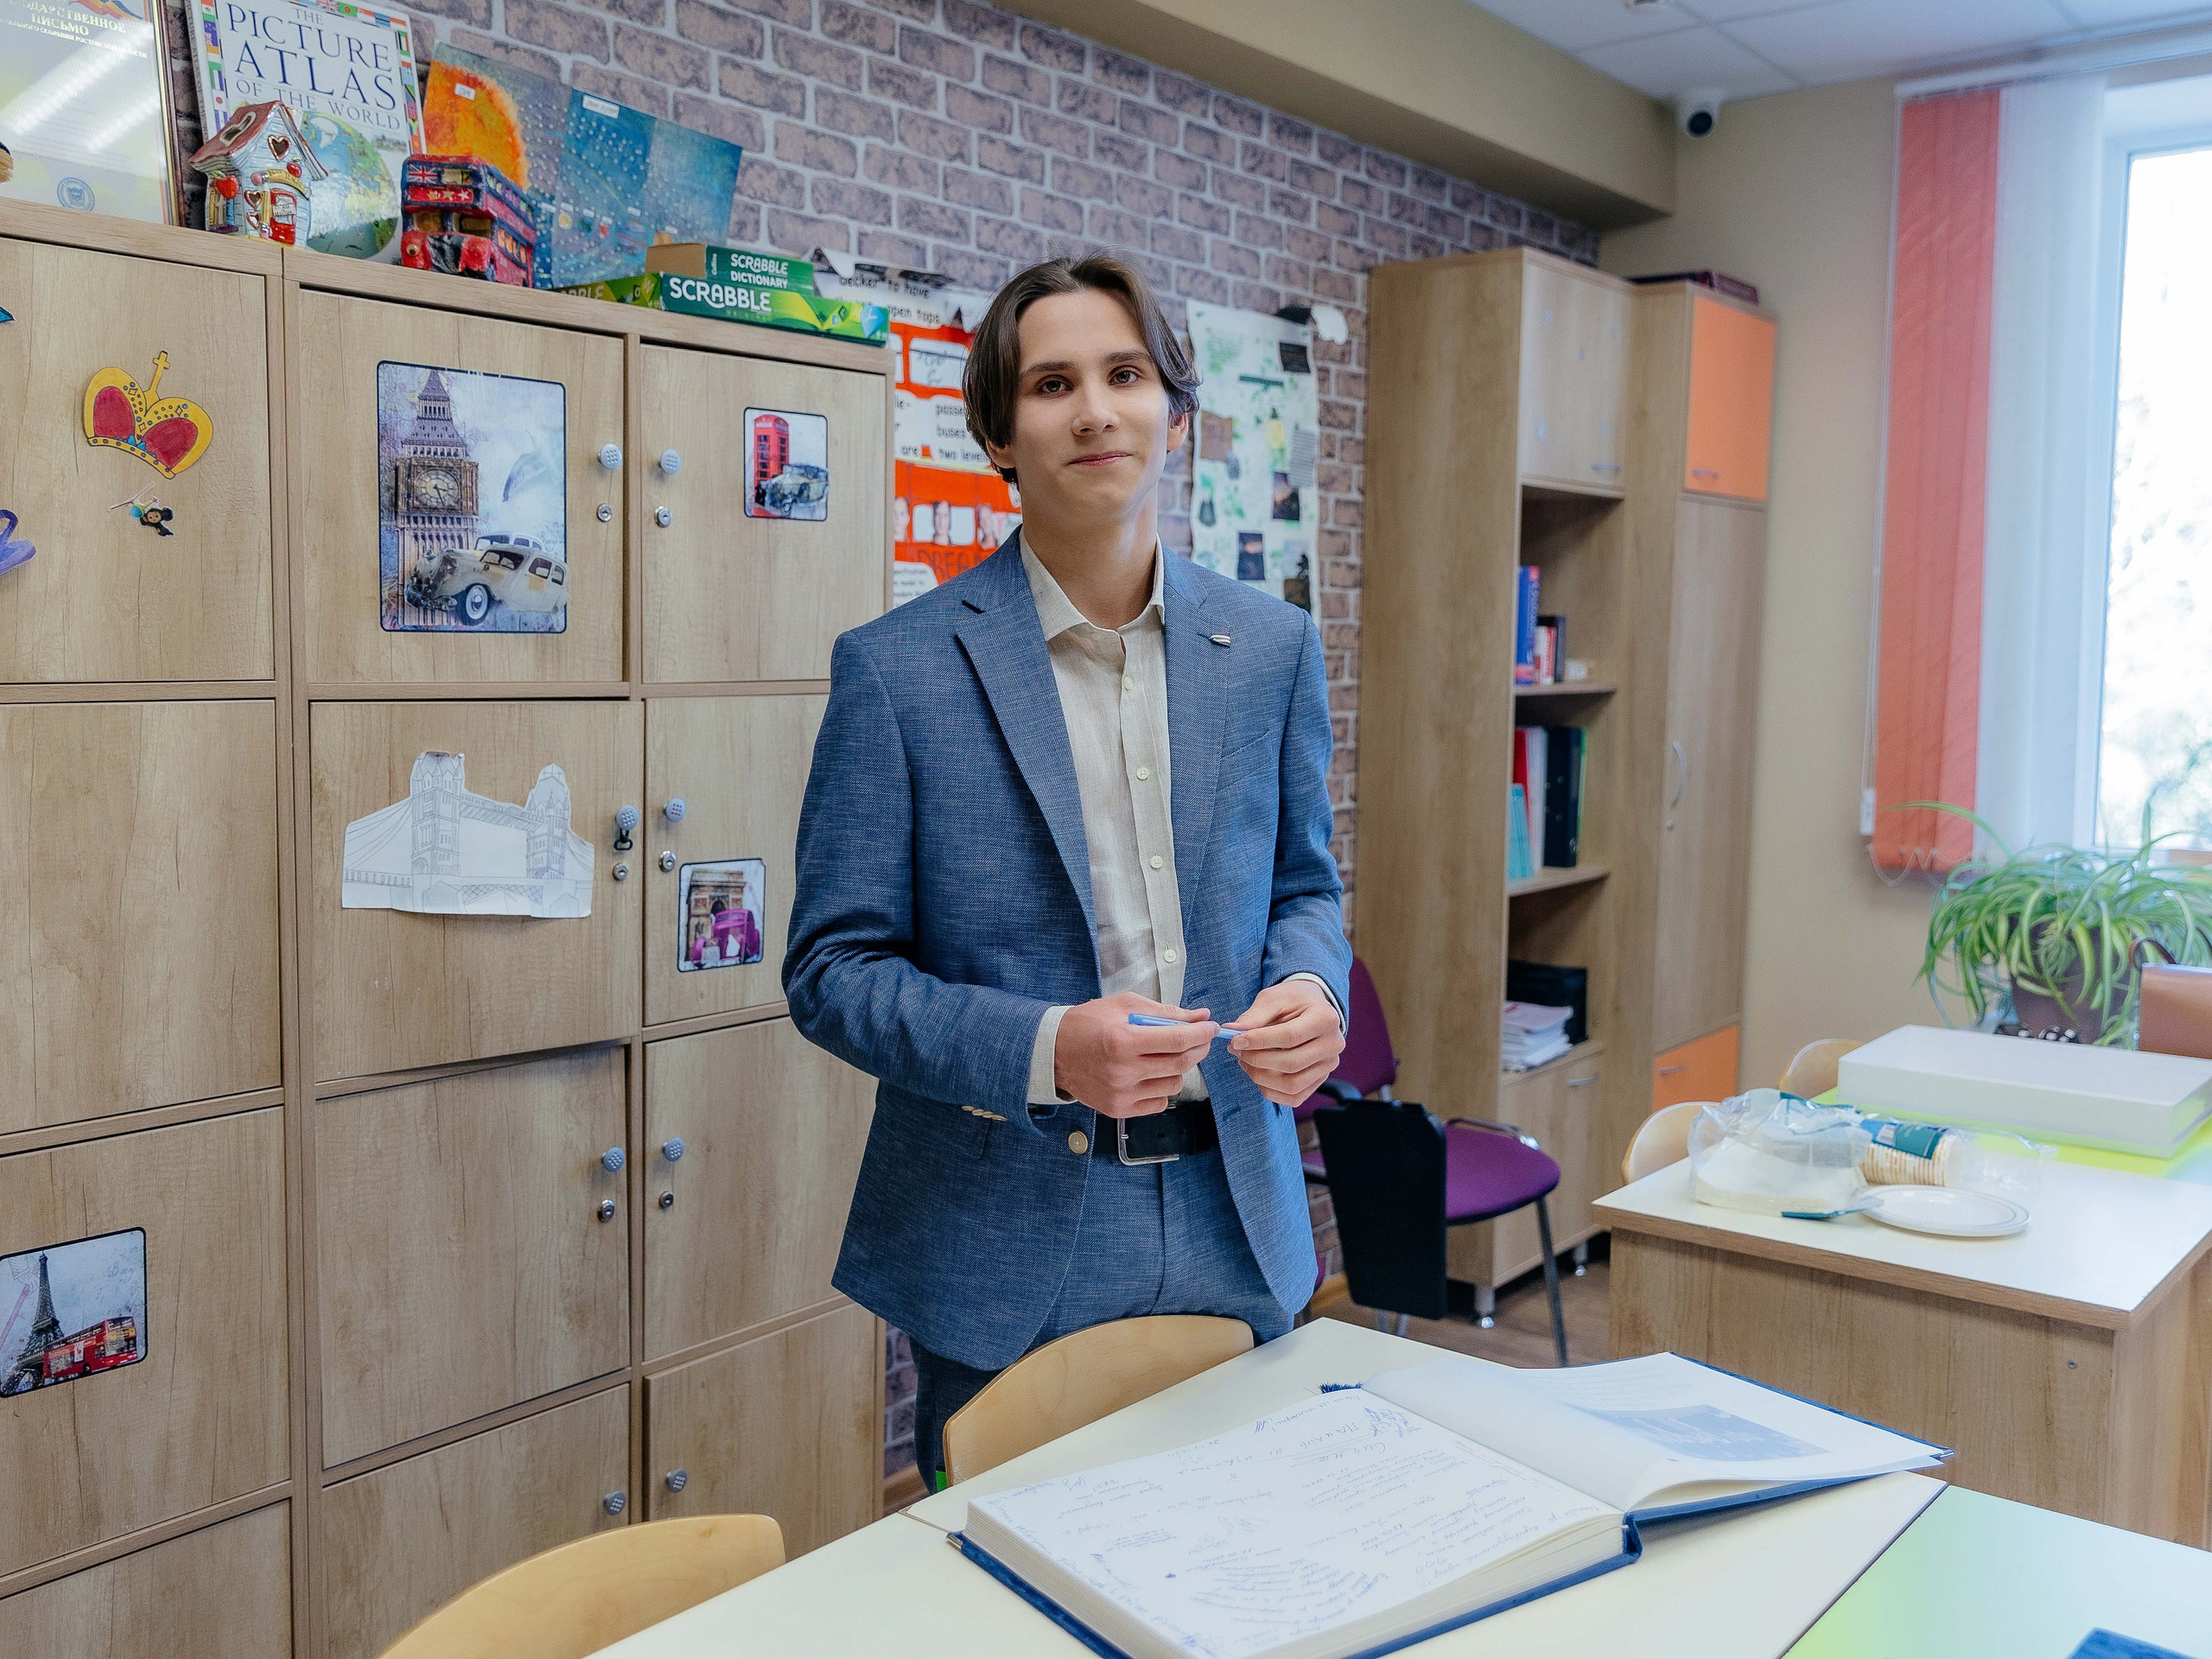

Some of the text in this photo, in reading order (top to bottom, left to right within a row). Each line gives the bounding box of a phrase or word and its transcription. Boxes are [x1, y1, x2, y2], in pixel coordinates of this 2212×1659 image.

[31, 13, 90, 36] ПИСЬМО
[293, 7, 324, 26] THE
[227, 3, 392, 73] PICTURE
[234, 40, 397, 111] ATLAS
[236, 79, 401, 130] OF THE WORLD
[730, 253, 789, 277] SCRABBLE
[730, 270, 789, 290] DICTIONARY
[669, 277, 772, 312] SCRABBLE
[936, 423, 968, 439] buses
[901, 445, 918, 458] are
[938, 448, 957, 460] two
